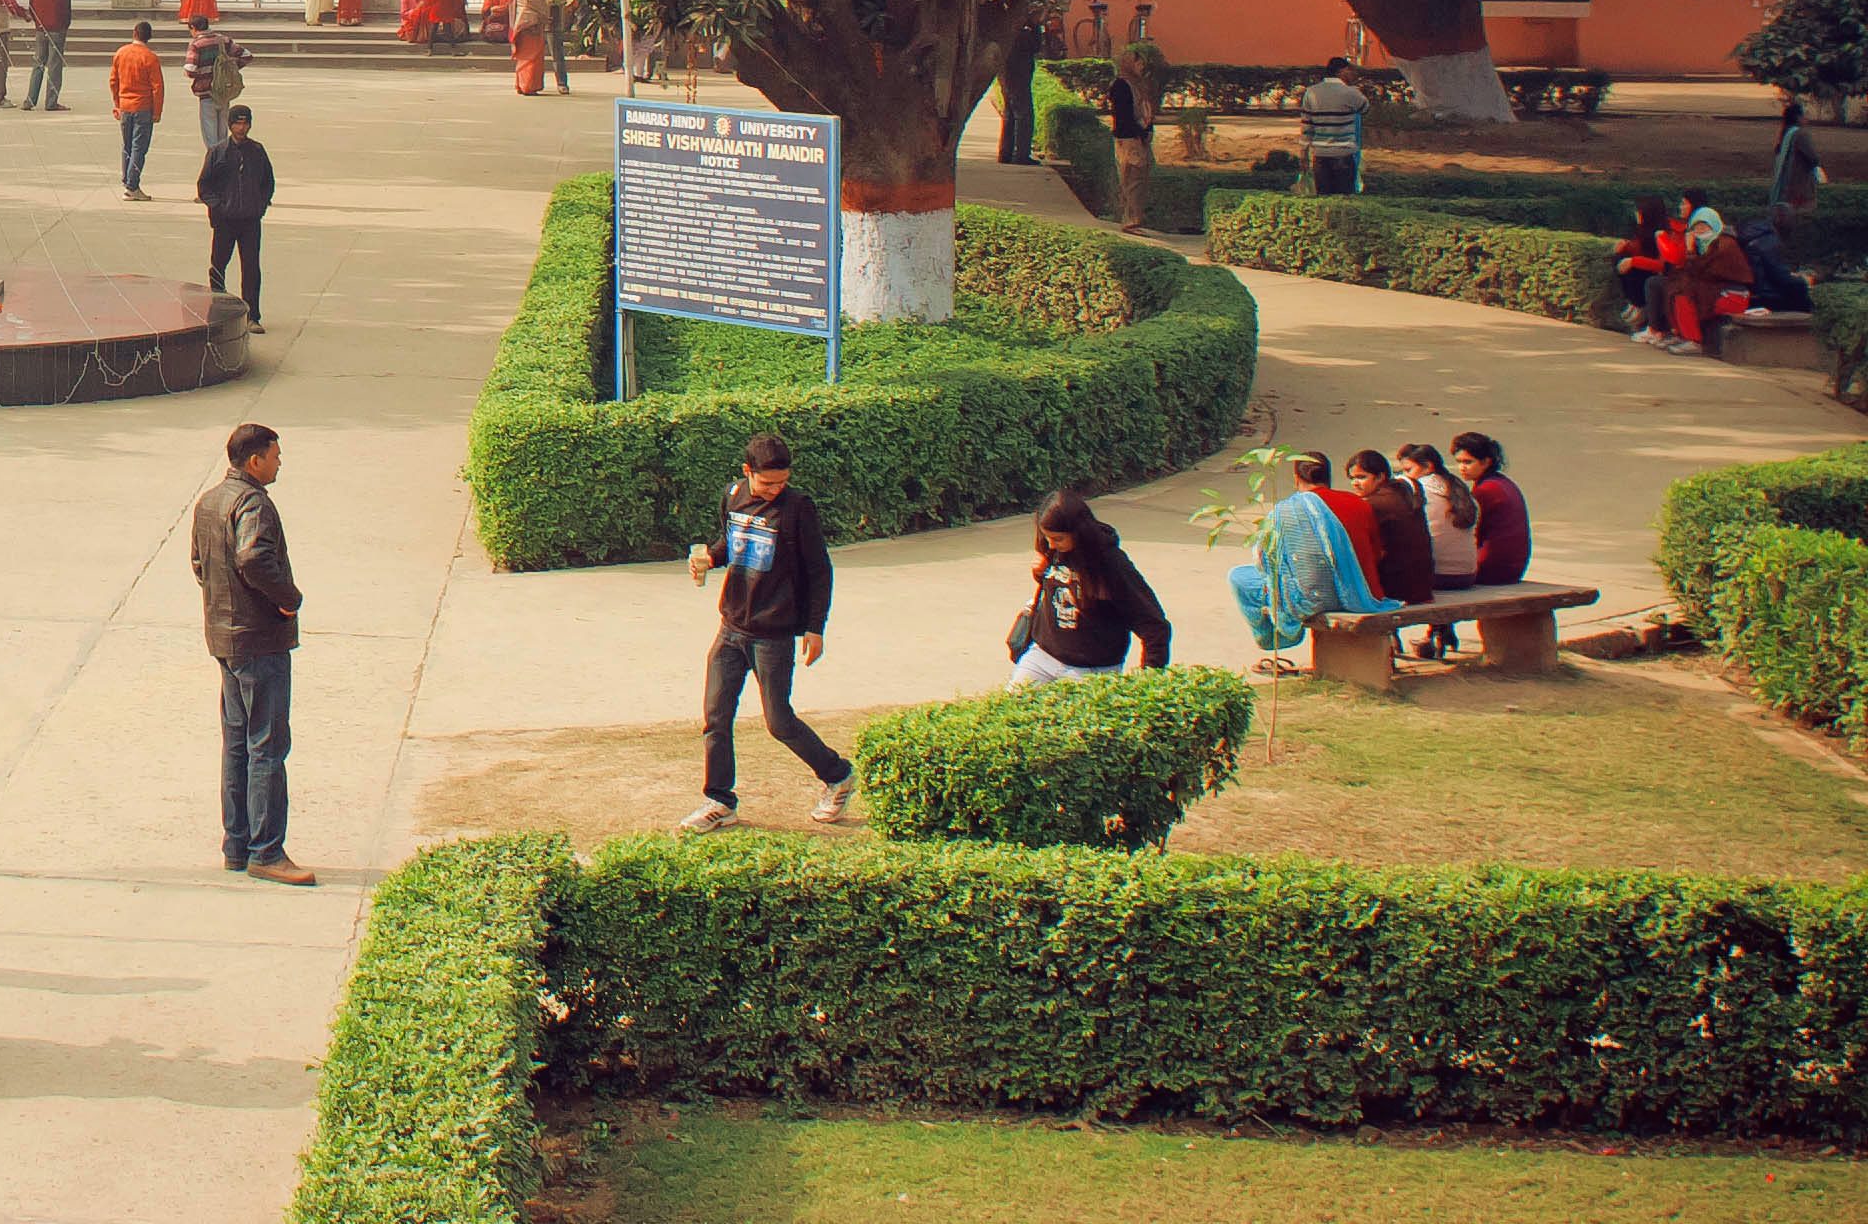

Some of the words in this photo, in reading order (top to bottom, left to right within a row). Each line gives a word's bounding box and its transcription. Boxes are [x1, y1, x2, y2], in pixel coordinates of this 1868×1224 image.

[625, 109, 671, 128] BANARAS
[671, 114, 707, 131] HINDU
[738, 120, 817, 140] UNIVERSITY
[622, 128, 663, 149] SHREE
[666, 132, 765, 159] VISHWANATH
[767, 142, 826, 165] MANDIR
[700, 154, 741, 170] NOTICE
